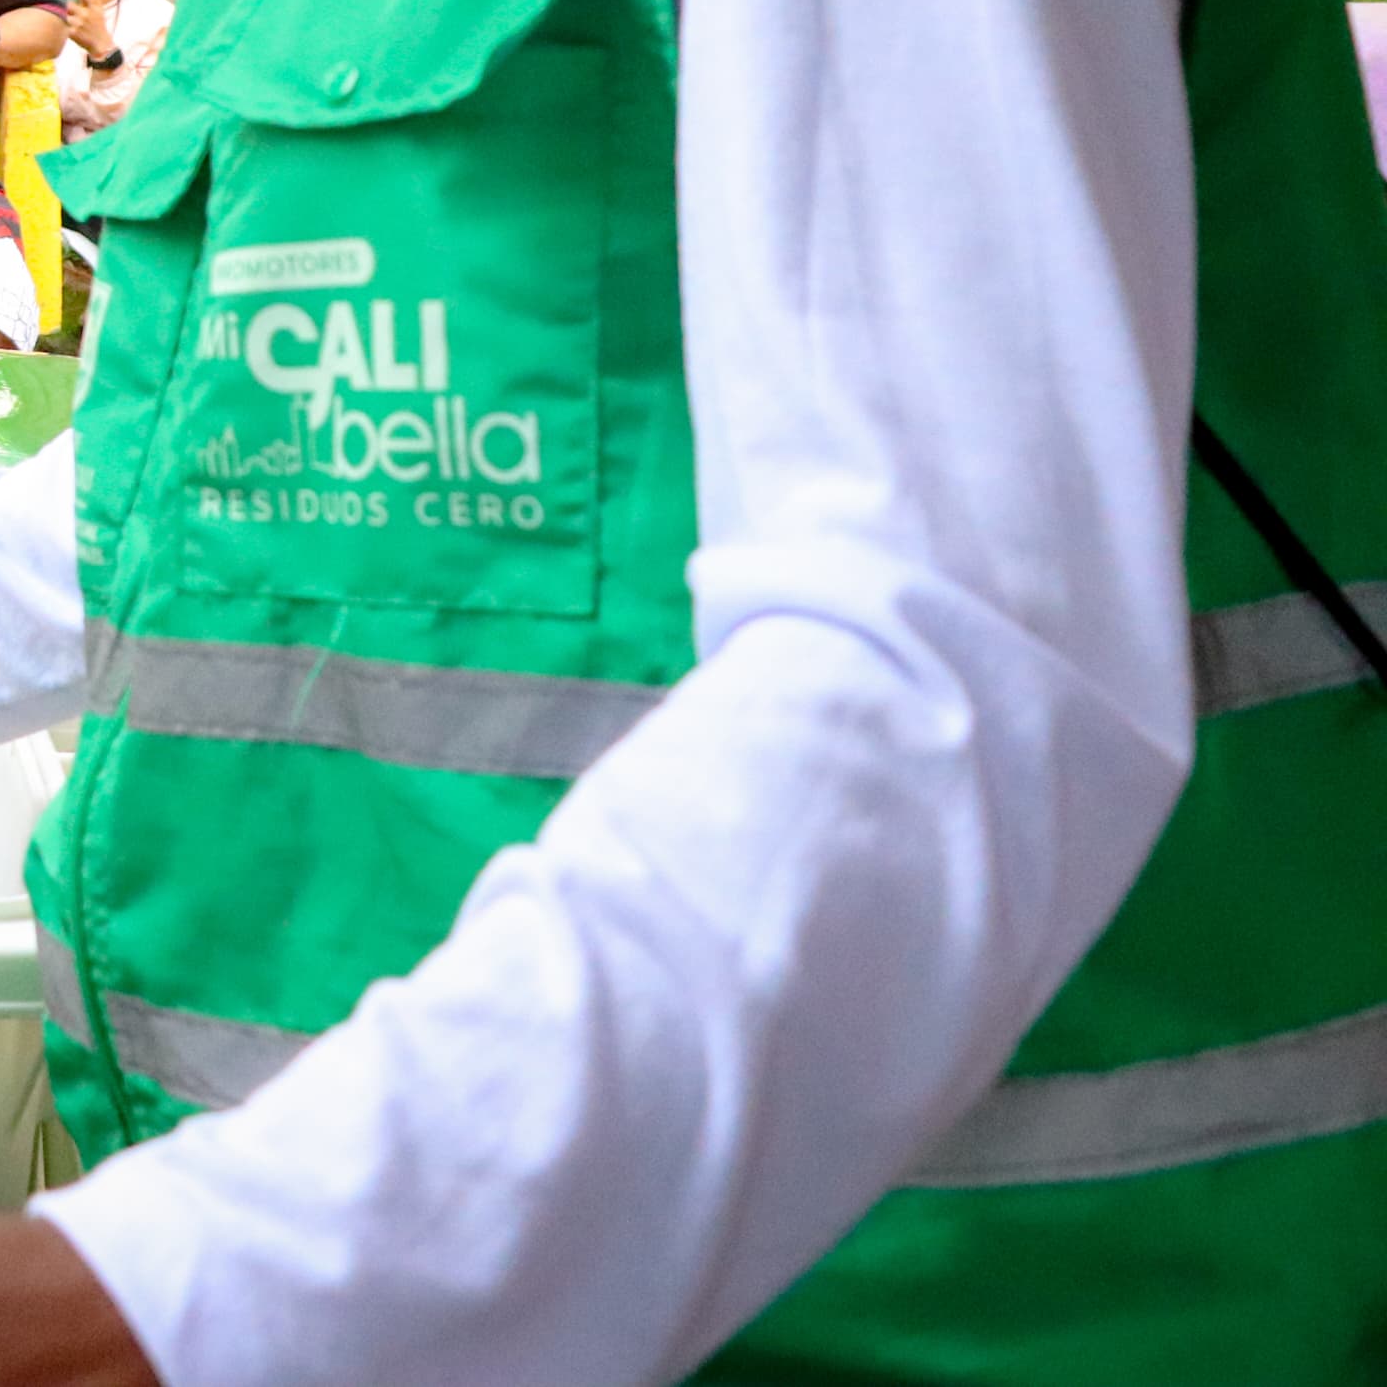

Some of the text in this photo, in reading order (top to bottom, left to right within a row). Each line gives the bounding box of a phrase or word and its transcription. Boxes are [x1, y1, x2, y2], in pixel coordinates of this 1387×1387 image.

[244, 298, 449, 426] CALI
[331, 394, 542, 485] bella
[198, 487, 546, 531] RESIDUOS CERO
